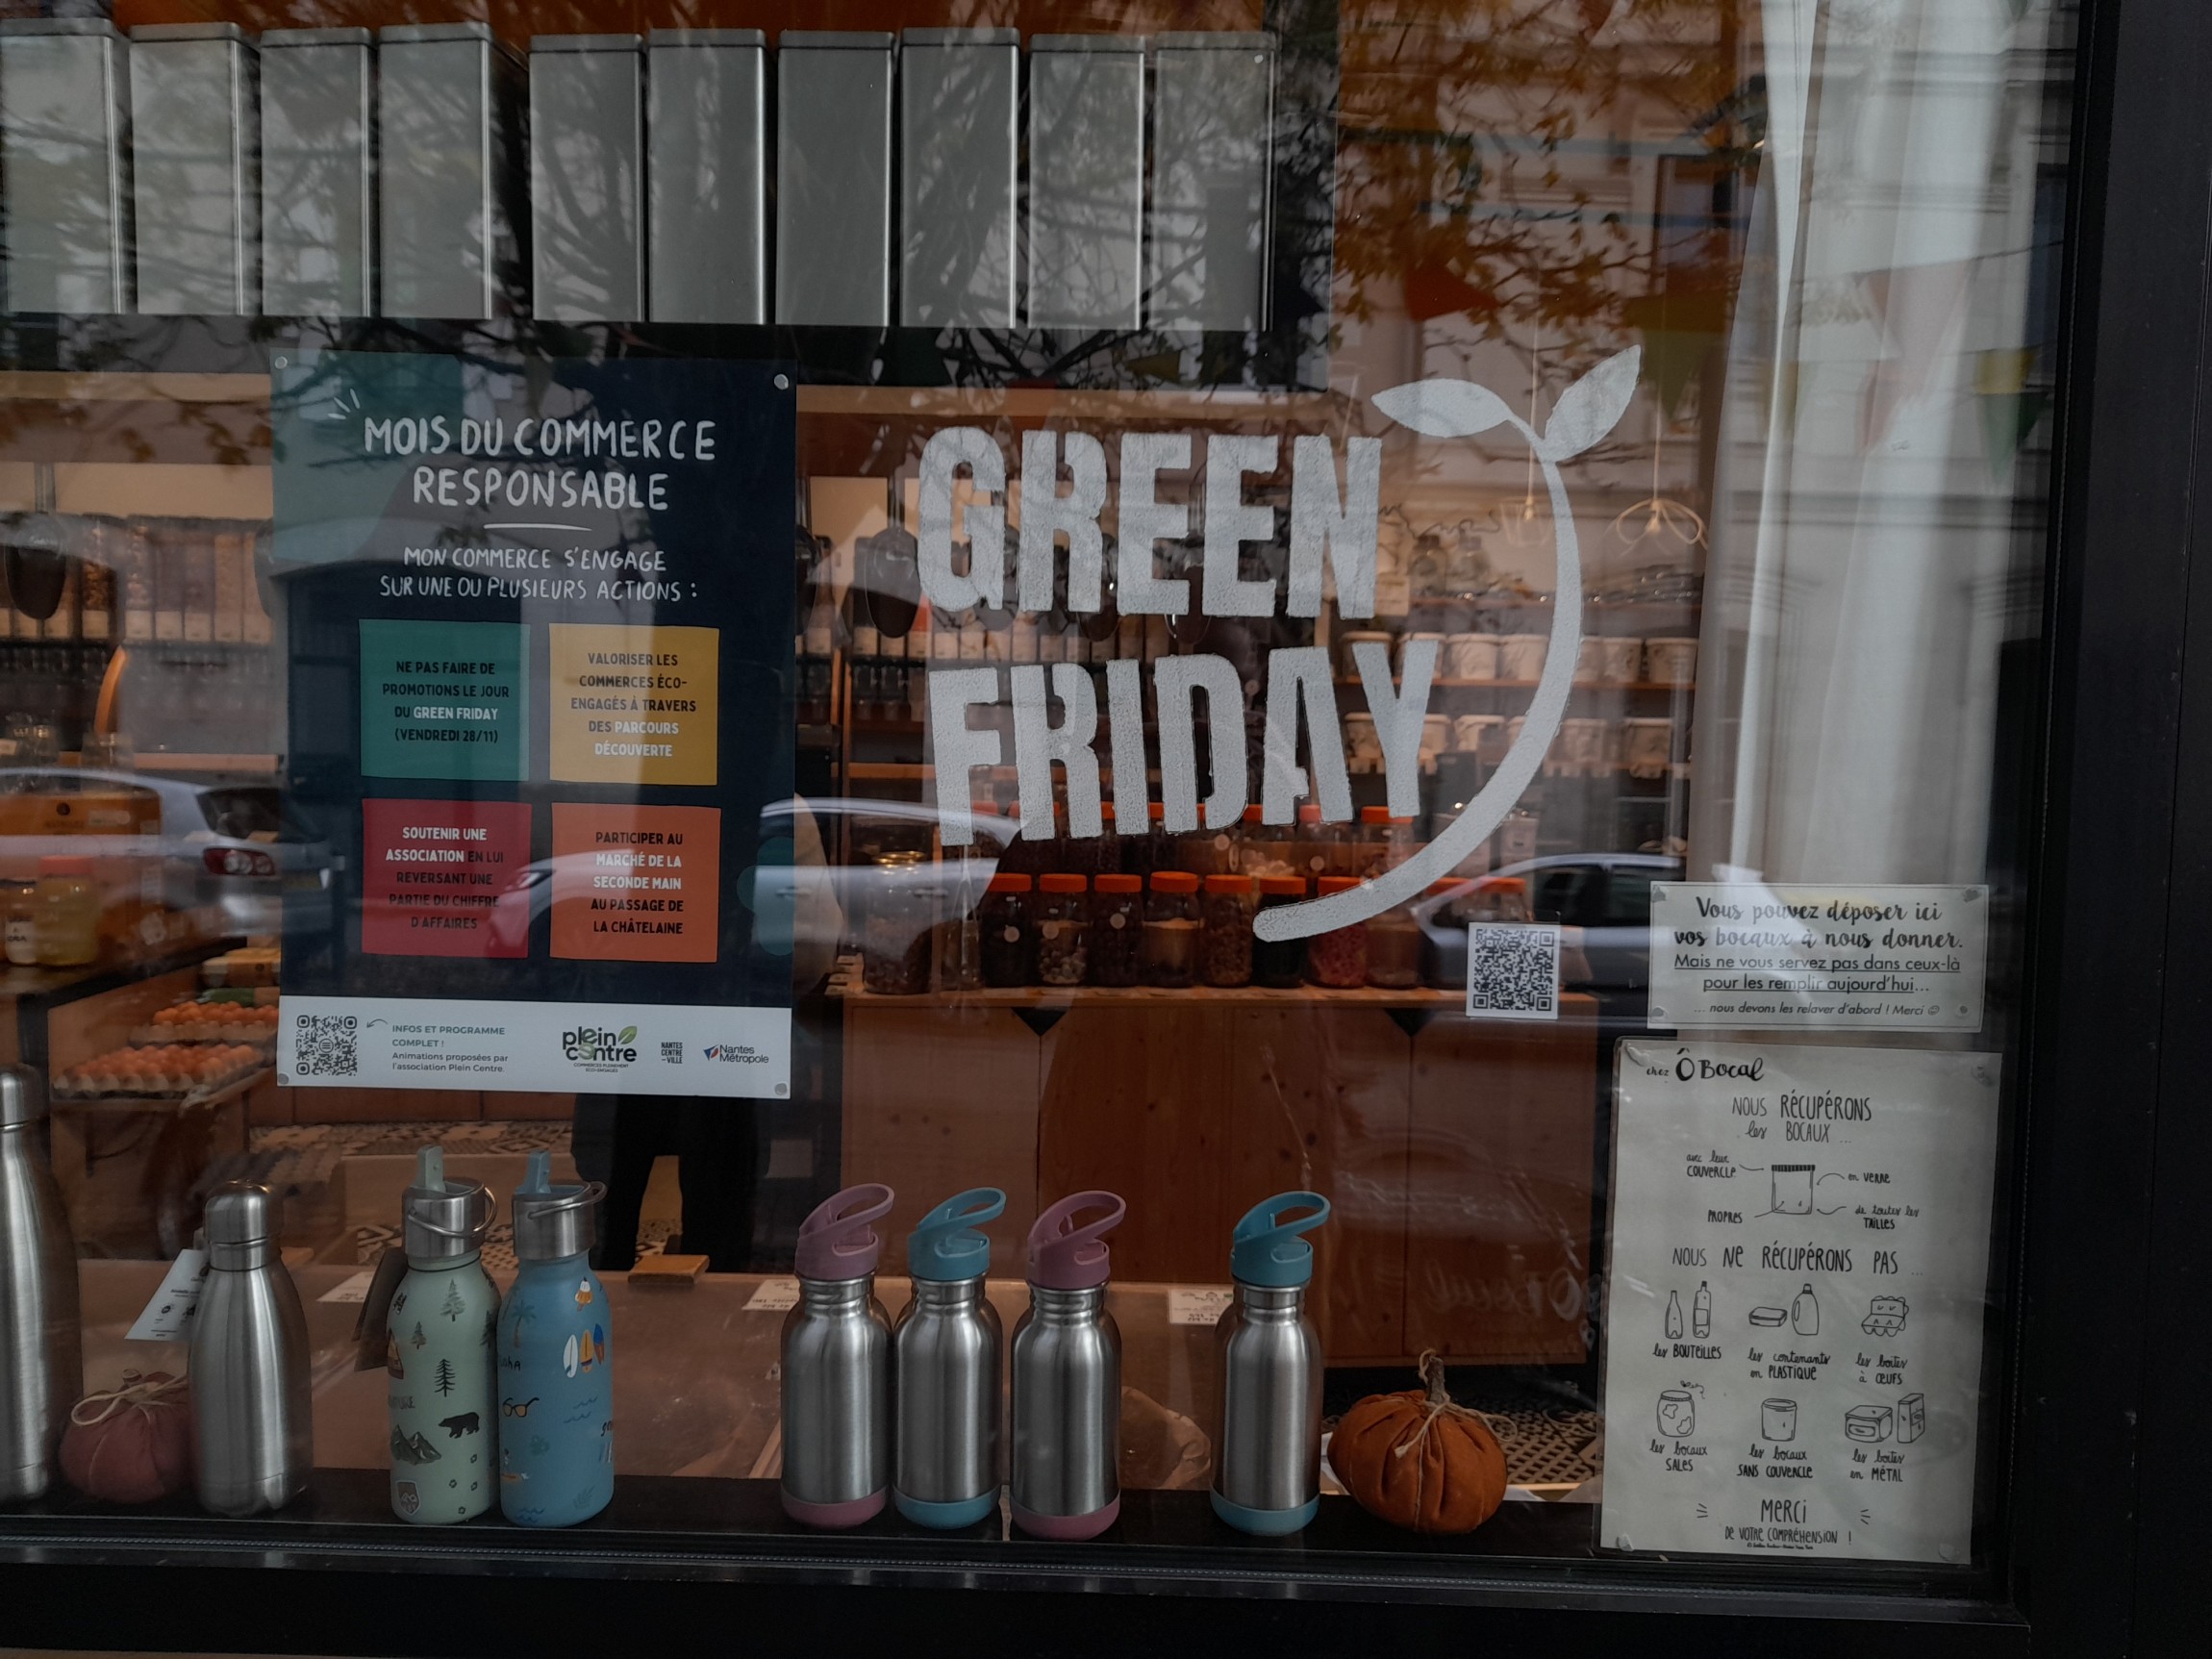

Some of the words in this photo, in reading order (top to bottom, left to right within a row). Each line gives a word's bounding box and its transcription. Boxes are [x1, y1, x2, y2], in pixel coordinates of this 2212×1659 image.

[364, 415, 450, 455] MOIS
[461, 417, 503, 457] DU
[514, 417, 716, 461] COMMERCE
[413, 465, 669, 511] RESPONSABLE
[917, 426, 1382, 619] GREEN
[403, 546, 447, 567] MON
[452, 546, 551, 569] COMMERCE
[564, 545, 666, 572] S'ENGAGE
[380, 575, 413, 597] SUR
[418, 577, 453, 597] UNE
[457, 577, 482, 597] OU
[487, 577, 587, 600] PLUSIEURS
[596, 579, 681, 602] ACTIONS
[588, 652, 653, 666] VALORISER
[657, 654, 678, 666] LES
[396, 661, 413, 673] NE
[415, 662, 440, 674] PAS
[442, 662, 477, 675] FAIRE
[480, 663, 495, 675] DE
[579, 675, 654, 689] COMMERCES
[657, 674, 688, 689] ÉCO-
[383, 683, 460, 697] PROMOTIONS
[463, 685, 477, 697] LE
[481, 685, 510, 697] JOUR
[570, 694, 627, 711] ENGAGÉS
[630, 695, 639, 711] À
[642, 699, 696, 712] TRAVERS
[394, 706, 411, 717] DU
[414, 706, 454, 719] GREEN
[456, 707, 498, 720] FRIDAY
[589, 720, 612, 732] DES
[615, 721, 679, 734] PARCOURS
[394, 728, 460, 742] (VENDREDI
[463, 729, 498, 743] 28/11)
[928, 640, 1439, 846] FRIDAY
[594, 740, 673, 757] DÉCOUVERTE
[402, 826, 460, 841] SOUTENIR
[463, 828, 487, 841] UNE
[595, 831, 664, 844] PARTICIPER
[666, 833, 683, 845] AU
[386, 848, 465, 862] ASSOCIATION
[467, 851, 483, 863] EN
[486, 851, 503, 863] LUI
[596, 851, 645, 867] MARCHÉ
[648, 854, 664, 867] DE
[666, 855, 682, 867] LA
[396, 871, 466, 885] REVERSANT
[469, 873, 493, 885] UNE
[593, 875, 649, 890] SECONDE
[652, 877, 682, 890] MAIN
[389, 893, 430, 906] PARTIE
[434, 894, 449, 907] DU
[453, 894, 500, 908] CHIFFRE
[591, 898, 607, 910] AU
[610, 898, 666, 912] PASSAGE
[668, 899, 684, 912] DE
[1696, 895, 1744, 920] Vous
[1752, 904, 1820, 925] pouvez
[1826, 900, 1908, 926] déposer
[1915, 901, 1943, 920] ici
[593, 920, 608, 933] LA
[611, 917, 684, 934] CHÂTELAINE
[1674, 929, 1707, 947] vos
[1715, 926, 1793, 948] bocaux
[1800, 928, 1818, 949] à
[1824, 931, 1873, 949] nous
[1882, 927, 1964, 949] donner.
[1674, 953, 1711, 968] Mais
[1716, 958, 1735, 968] ne
[1740, 958, 1773, 968] vous
[1778, 958, 1827, 969] servez
[1831, 958, 1859, 973] pas
[1864, 953, 1900, 971] dans
[1905, 955, 1960, 971] ceux-là
[1703, 976, 1739, 993] pour
[1744, 973, 1764, 990] les
[1768, 974, 1823, 993] remplir
[1709, 1004, 1735, 1014] nous
[1738, 1001, 1777, 1015] devons
[1779, 1001, 1794, 1015] les
[1797, 1002, 1835, 1015] relaver
[1837, 1002, 1881, 1016] d'abord
[1892, 1004, 1924, 1016] Merci
[392, 1024, 422, 1034] INFOS
[425, 1025, 438, 1035] ET
[440, 1025, 505, 1036] PROGRAMME
[563, 1025, 616, 1050] plein
[392, 1039, 439, 1047] COMPLET
[719, 1044, 755, 1054] Nantes
[392, 1051, 444, 1061] Animations
[445, 1052, 492, 1064] proposées
[493, 1054, 509, 1065] par
[566, 1043, 638, 1063] centre
[661, 1048, 683, 1057] CENTRE
[719, 1052, 769, 1065] Métropole
[392, 1062, 446, 1072] l'association
[448, 1063, 471, 1072] Plein
[473, 1064, 505, 1073] Centre.
[1646, 1066, 1670, 1076] chez
[1699, 1057, 1765, 1081] Bocal
[1732, 1096, 1768, 1117] NOUS
[1746, 1120, 1768, 1140] les
[1786, 1120, 1831, 1144] BOCAUX
[1686, 1153, 1702, 1163] avec
[1848, 1172, 1859, 1181] en
[1855, 1204, 1867, 1215] de
[1872, 1203, 1901, 1217] toutes
[1904, 1204, 1921, 1218] les
[1672, 1246, 1707, 1269] NOUS
[1873, 1250, 1898, 1275] PAS
[1652, 1343, 1669, 1358] les
[1747, 1347, 1764, 1362] les
[1772, 1349, 1831, 1366] contenants
[1854, 1352, 1872, 1368] les
[1750, 1370, 1763, 1379] en
[1858, 1370, 1868, 1383] à
[1649, 1439, 1666, 1454] les
[1673, 1441, 1708, 1456] bocaux
[1747, 1444, 1765, 1459] les
[1772, 1445, 1808, 1461] bocaux
[1851, 1447, 1868, 1464] les
[1736, 1464, 1759, 1477] SANS
[1849, 1470, 1864, 1480] en
